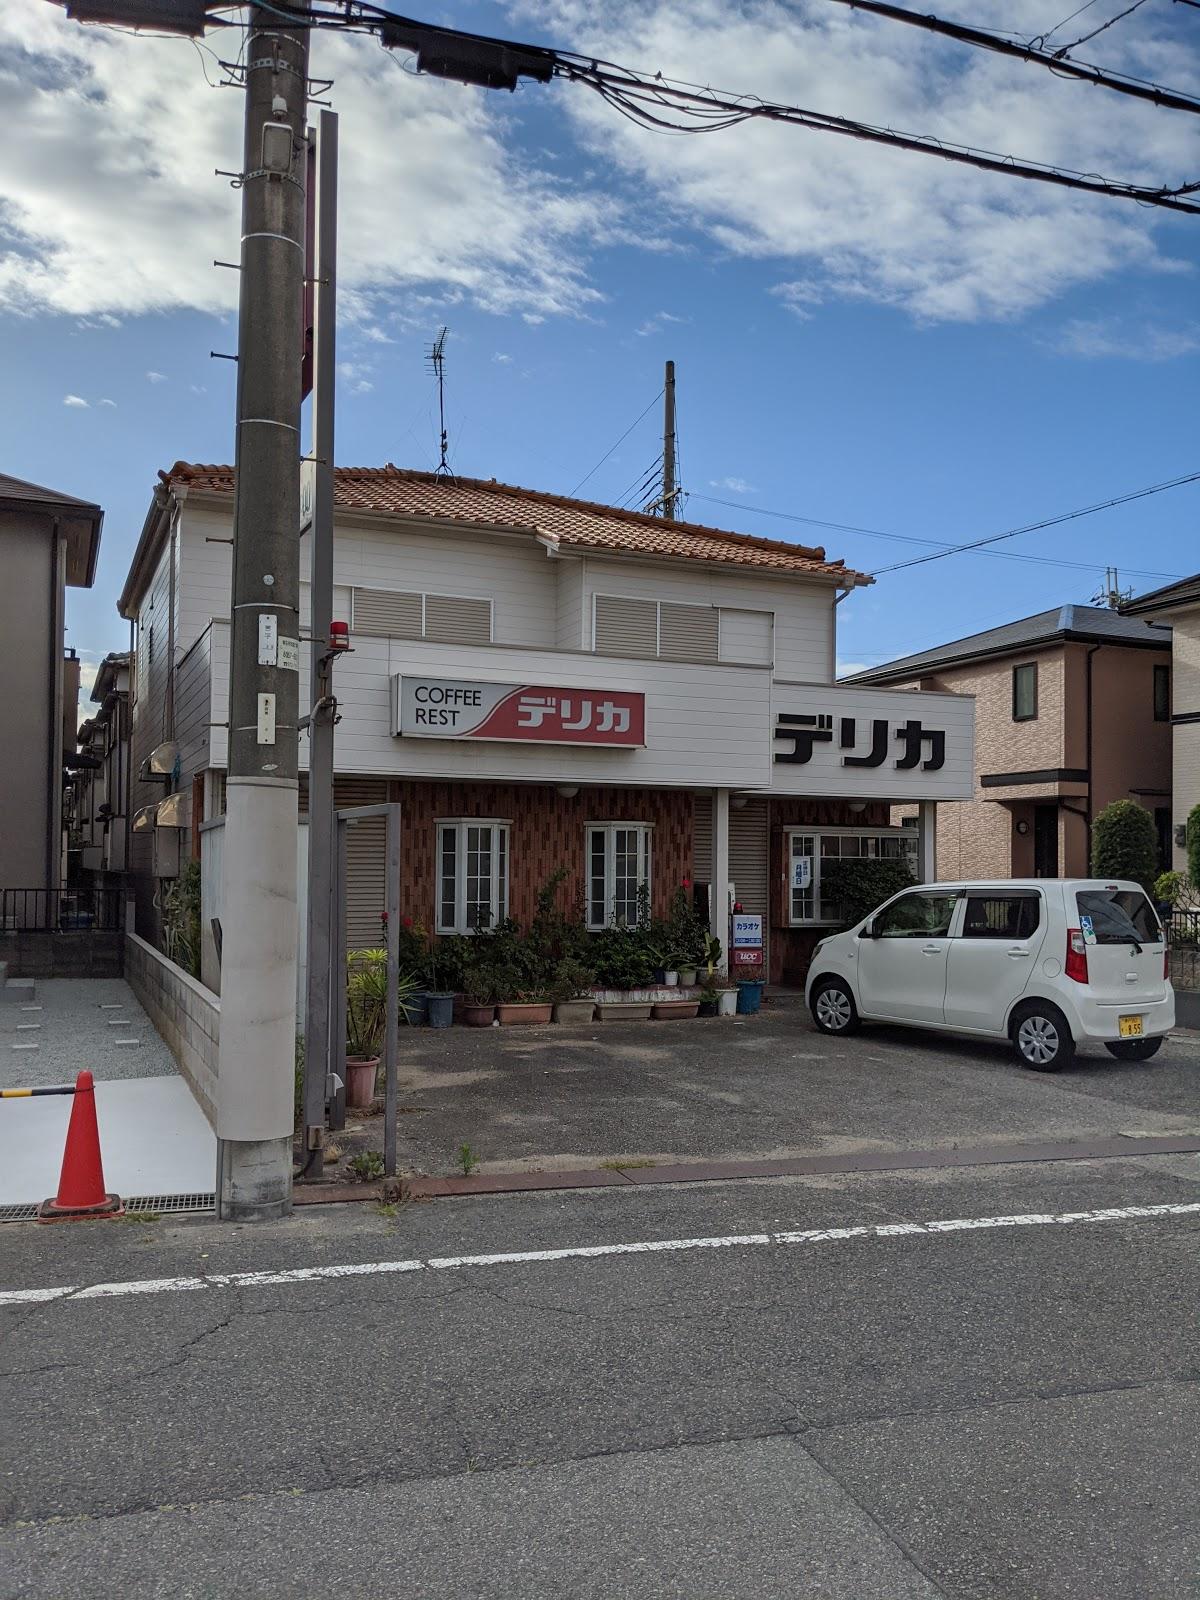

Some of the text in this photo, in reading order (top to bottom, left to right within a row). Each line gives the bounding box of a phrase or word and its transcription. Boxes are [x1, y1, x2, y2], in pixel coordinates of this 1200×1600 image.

[415, 686, 482, 706] COFFEE
[415, 708, 461, 727] REST
[517, 696, 631, 733] デリカ
[774, 713, 945, 770] デリカ
[736, 922, 760, 931] カラオケ
